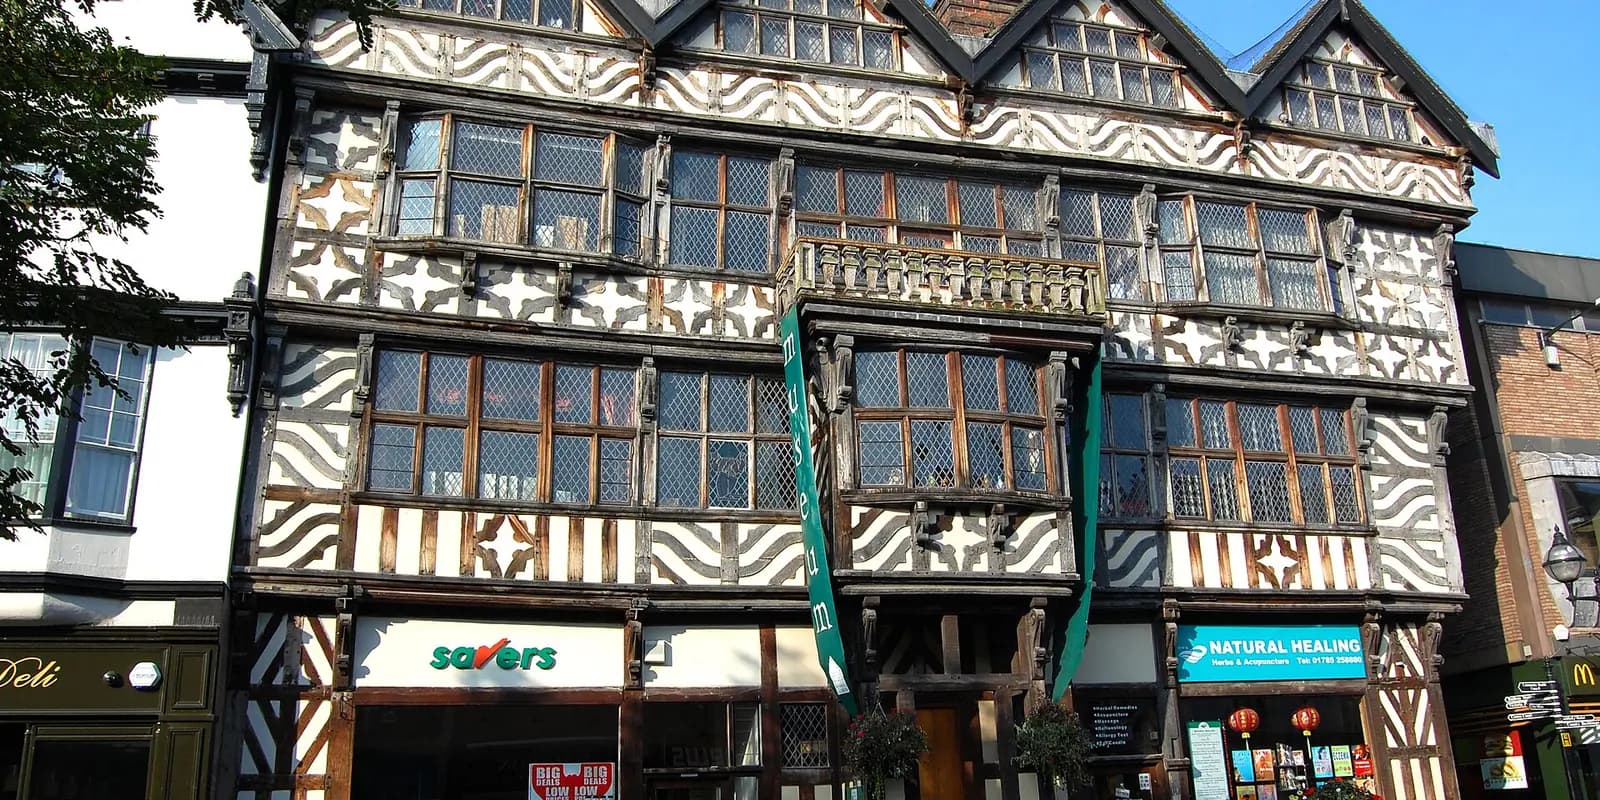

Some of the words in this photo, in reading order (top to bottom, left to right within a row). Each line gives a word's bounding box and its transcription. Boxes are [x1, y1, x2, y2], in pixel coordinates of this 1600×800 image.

[783, 331, 833, 634] museum
[429, 637, 557, 671] savers
[1209, 640, 1288, 655] NATURAL
[1291, 639, 1361, 653] HEALING
[1211, 658, 1234, 667] Herbs
[1235, 658, 1242, 667] &
[1244, 658, 1290, 667] Acupuncture
[0, 657, 61, 688] Deli
[536, 767, 560, 779] BIG
[583, 766, 607, 778] BIG
[545, 786, 570, 797] LOW
[574, 786, 598, 796] LOW
